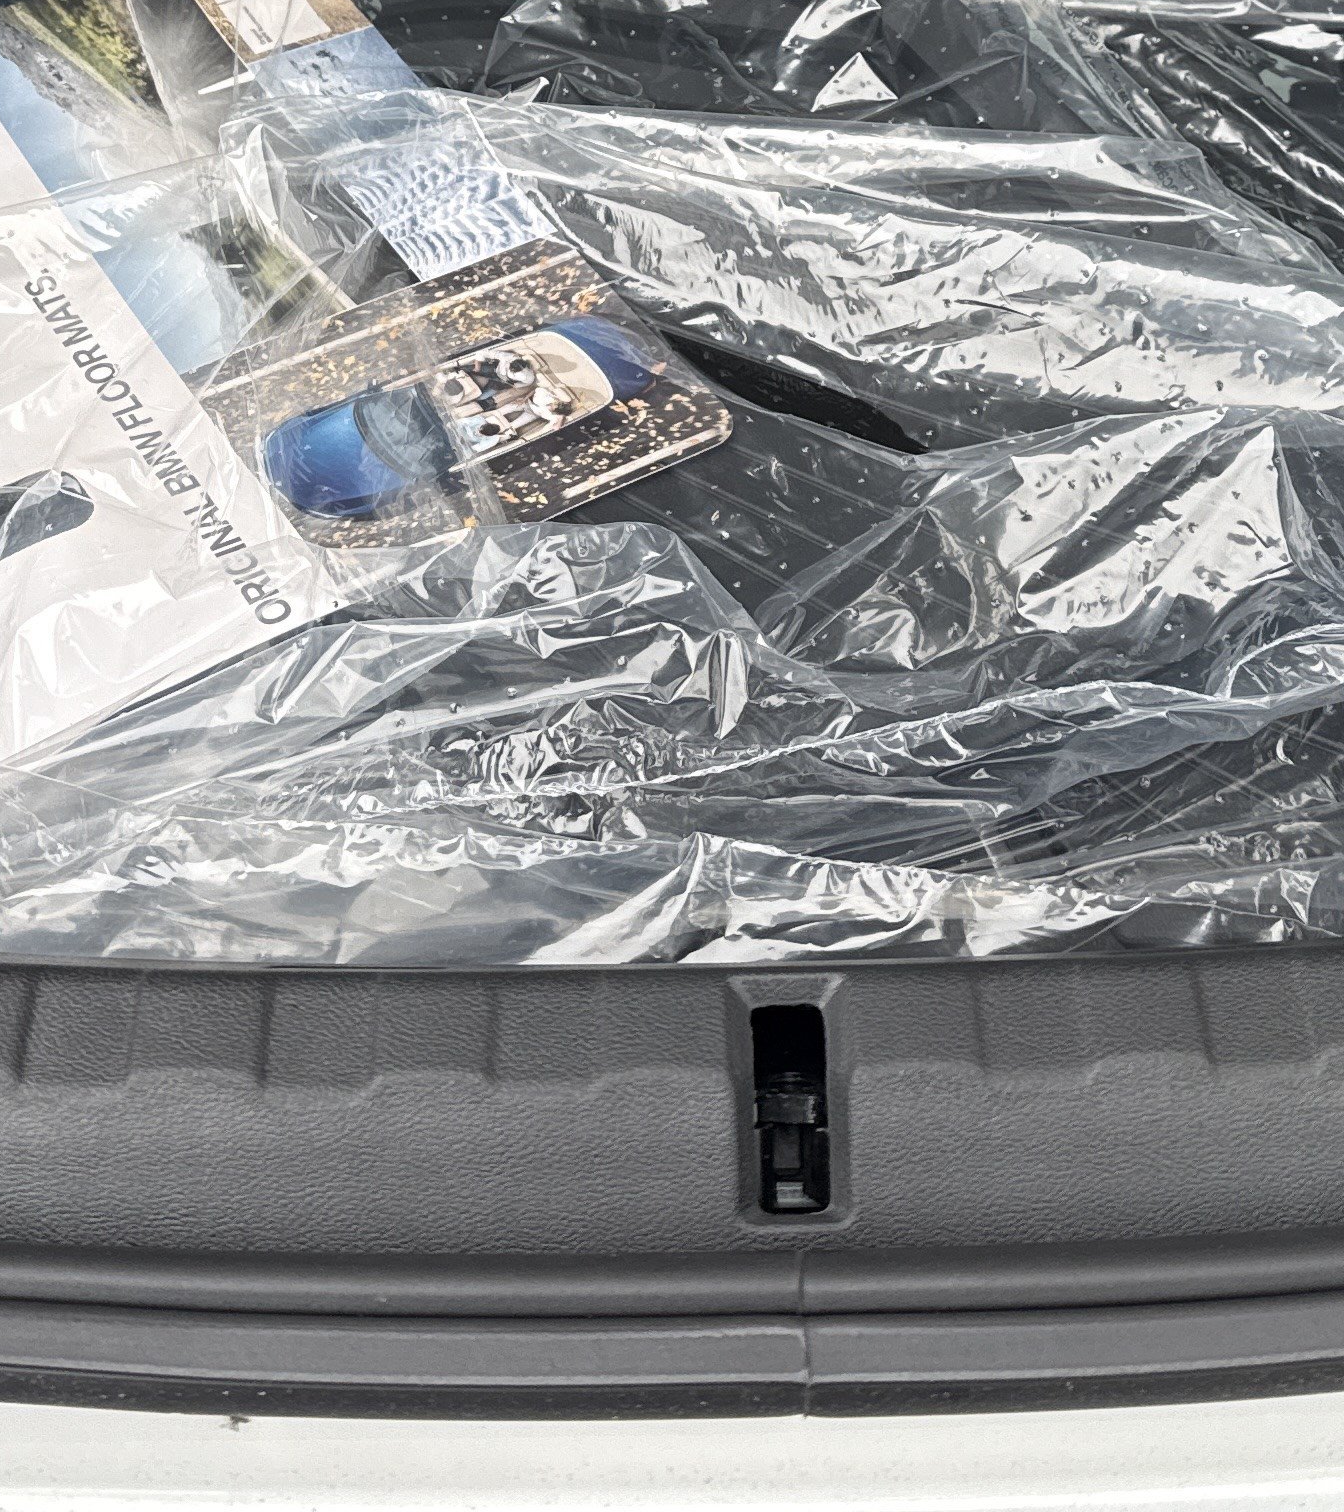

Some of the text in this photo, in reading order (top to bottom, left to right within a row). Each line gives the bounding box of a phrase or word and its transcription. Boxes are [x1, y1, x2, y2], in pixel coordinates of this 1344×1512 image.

[23, 267, 292, 626] ORIGINAL BMW FLOOR MATS.
